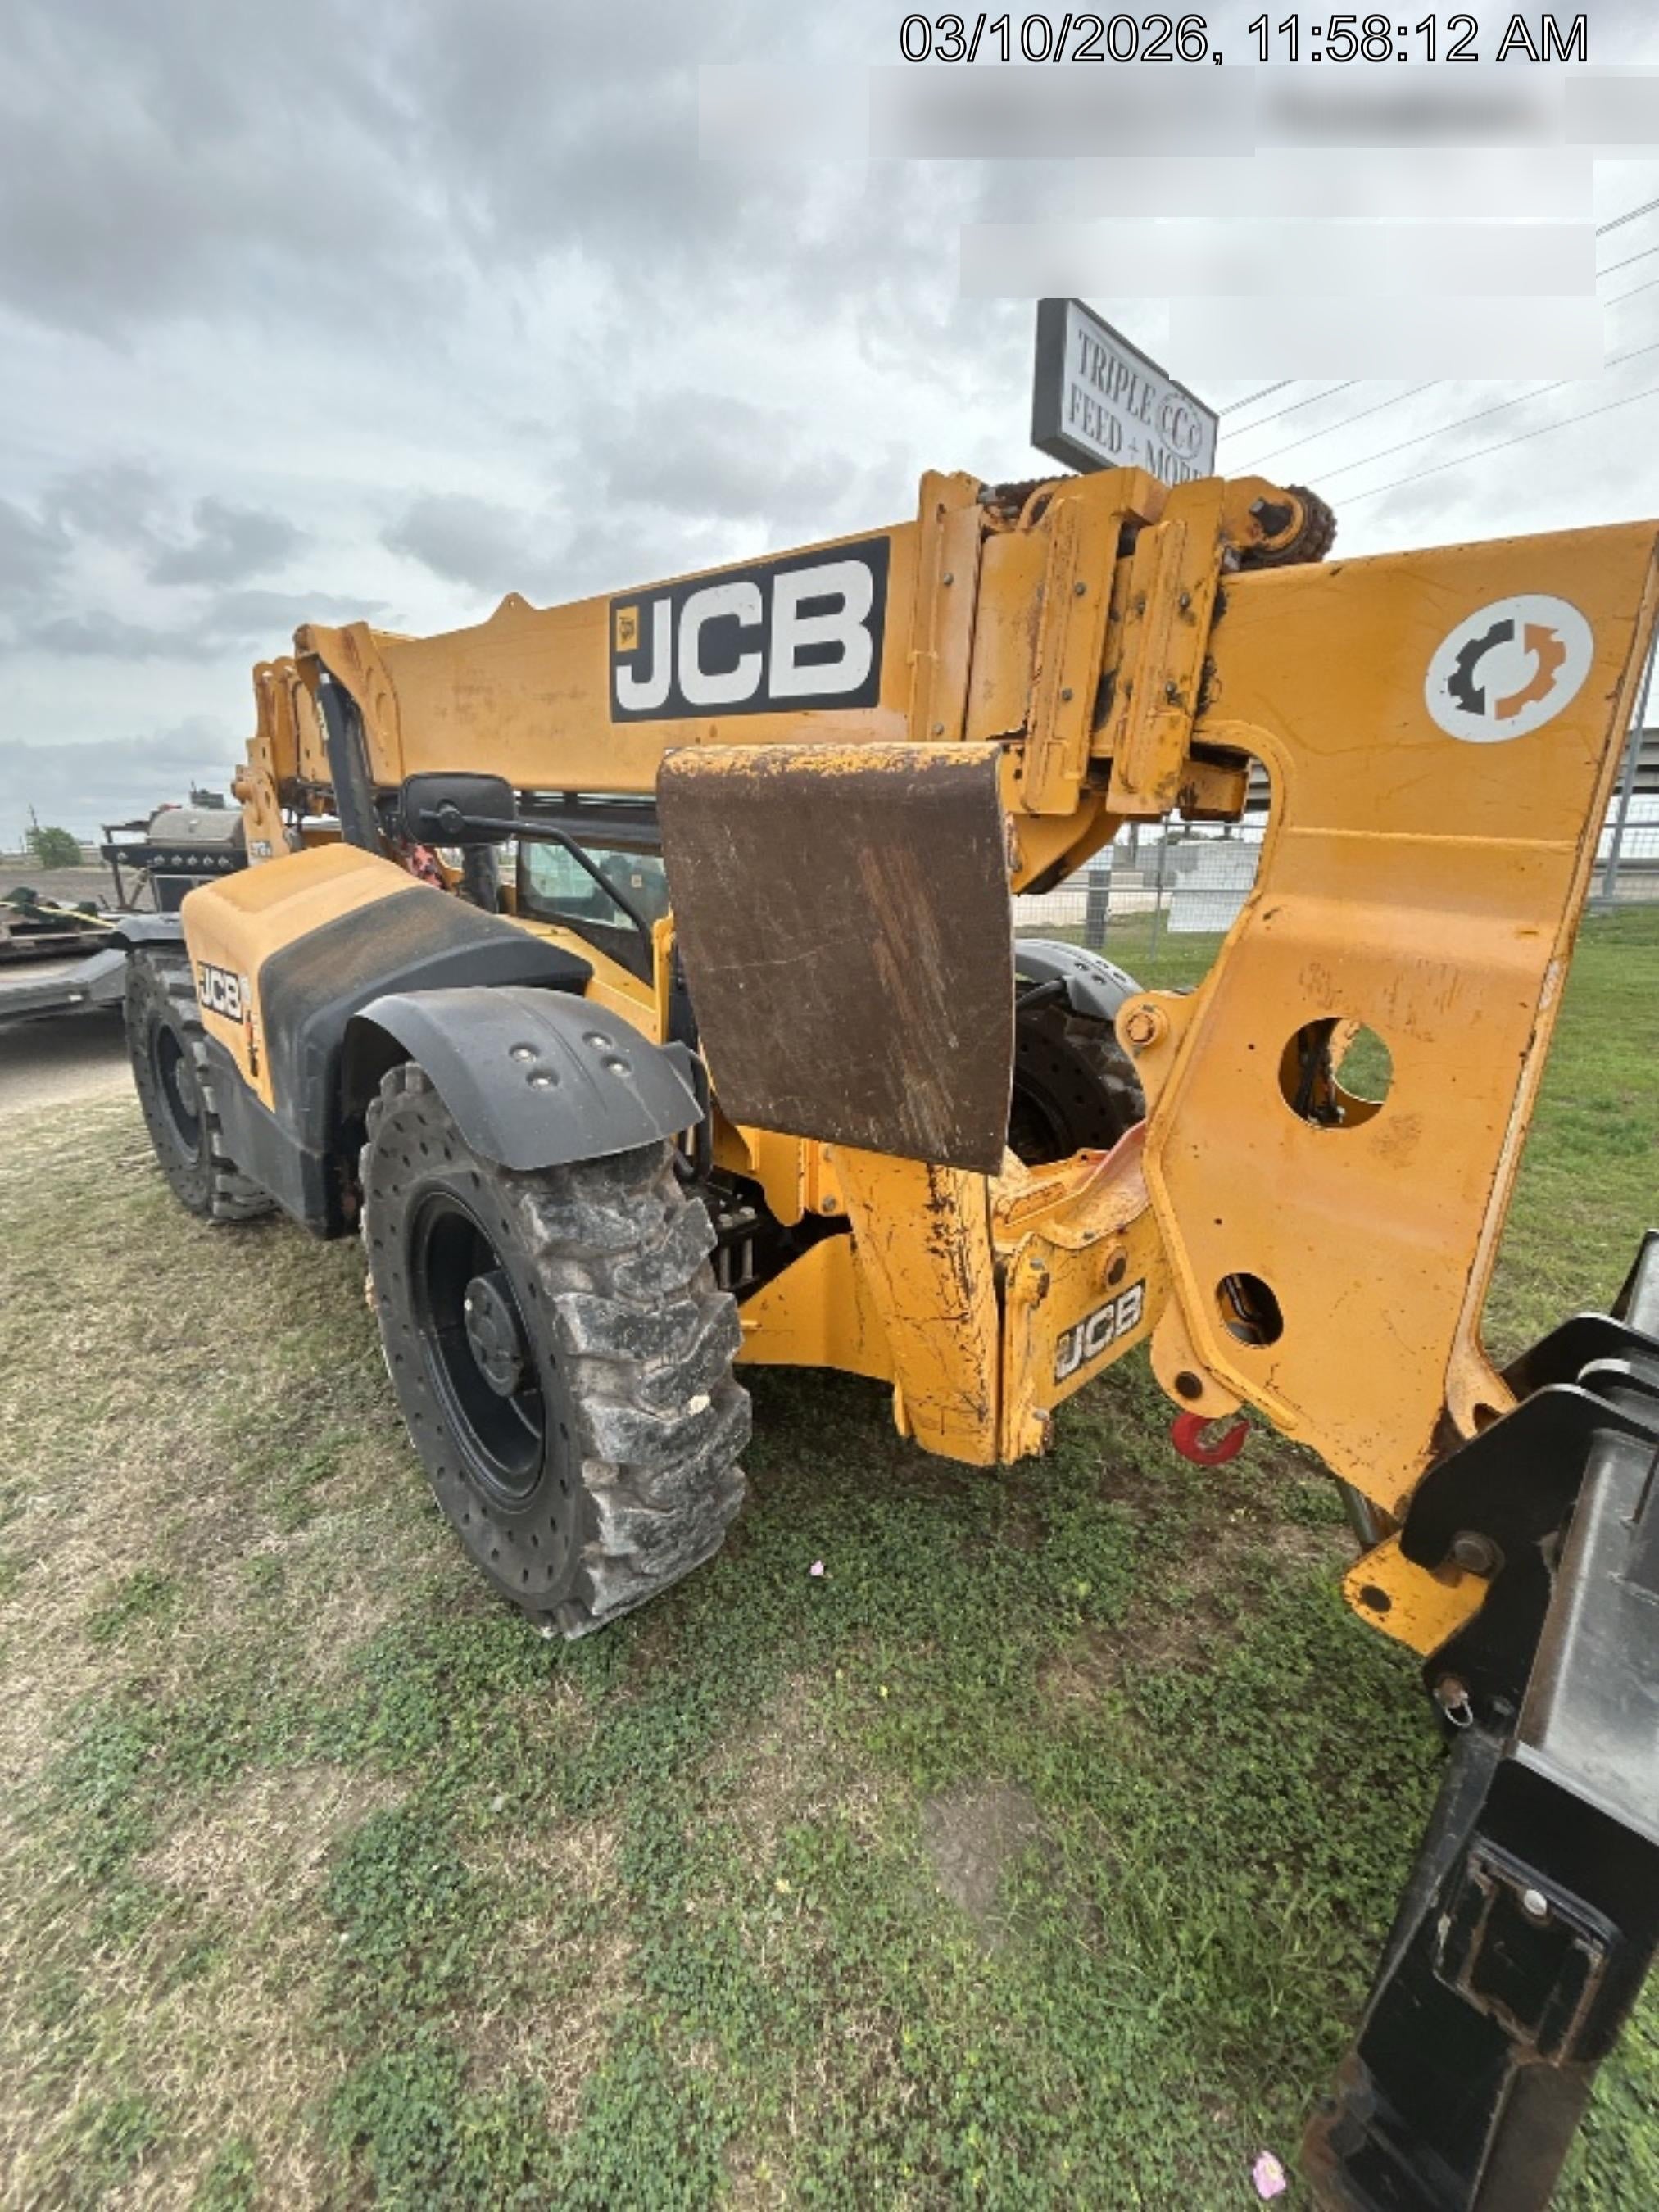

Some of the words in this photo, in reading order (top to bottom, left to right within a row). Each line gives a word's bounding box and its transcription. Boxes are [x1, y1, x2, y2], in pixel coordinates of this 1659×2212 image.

[1068, 383, 1122, 454] FEED
[1078, 329, 1156, 425] TRIPLE
[615, 560, 874, 711] JCB
[199, 965, 243, 1019] JCB
[1056, 1284, 1144, 1379] JCB
